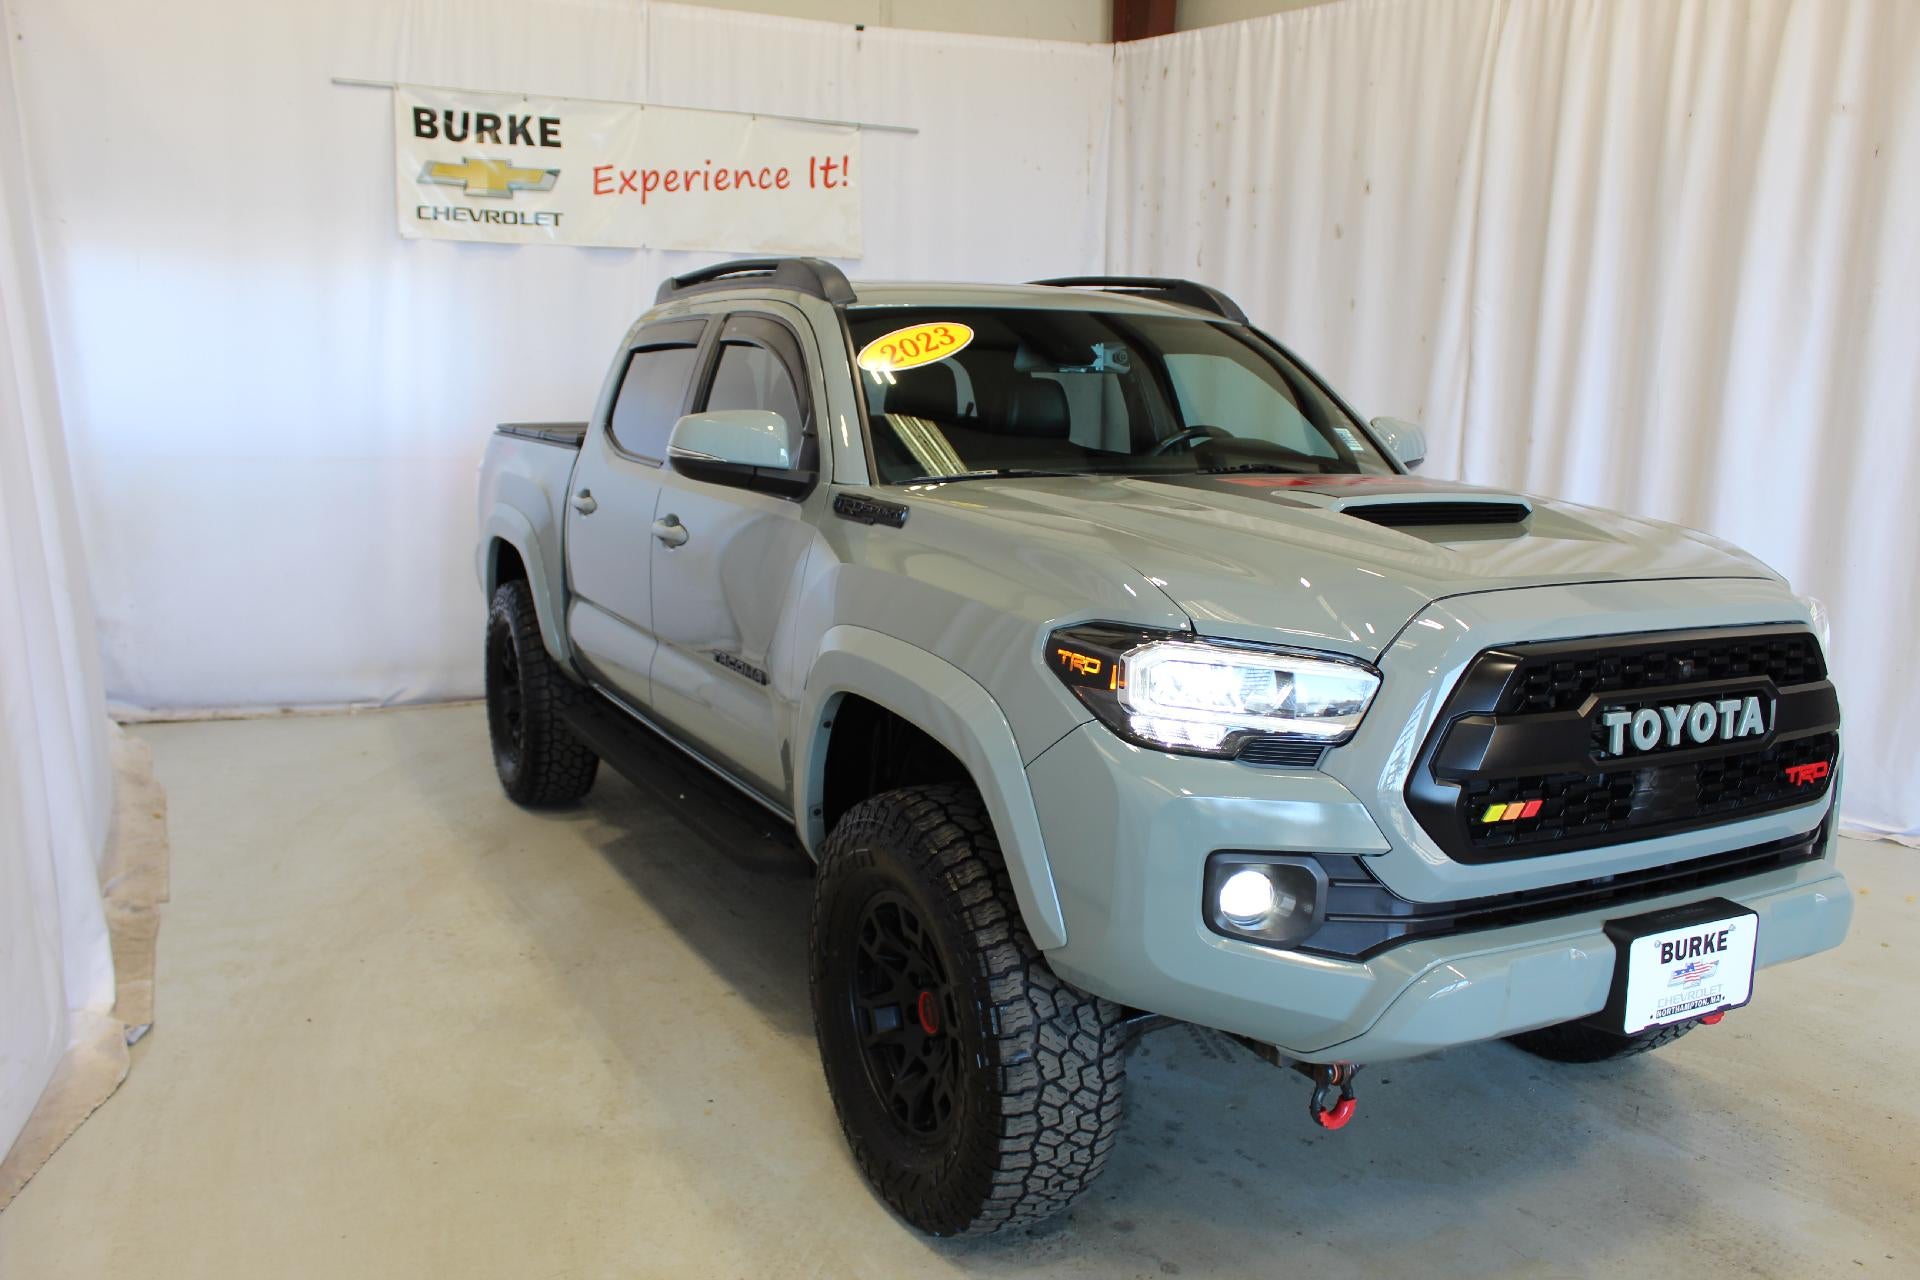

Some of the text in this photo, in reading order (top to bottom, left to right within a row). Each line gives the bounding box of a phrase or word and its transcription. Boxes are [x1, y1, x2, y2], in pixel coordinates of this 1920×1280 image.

[412, 106, 562, 148] BURKE
[592, 154, 850, 205] Experience It!
[415, 204, 564, 228] CHEVROLET
[879, 326, 956, 365] 2023
[1057, 648, 1101, 677] TRD
[1602, 696, 1765, 756] TOYOTA
[1784, 760, 1830, 787] TRD
[1660, 929, 1729, 965] BURKE
[1657, 983, 1724, 1009] CHEVROLET
